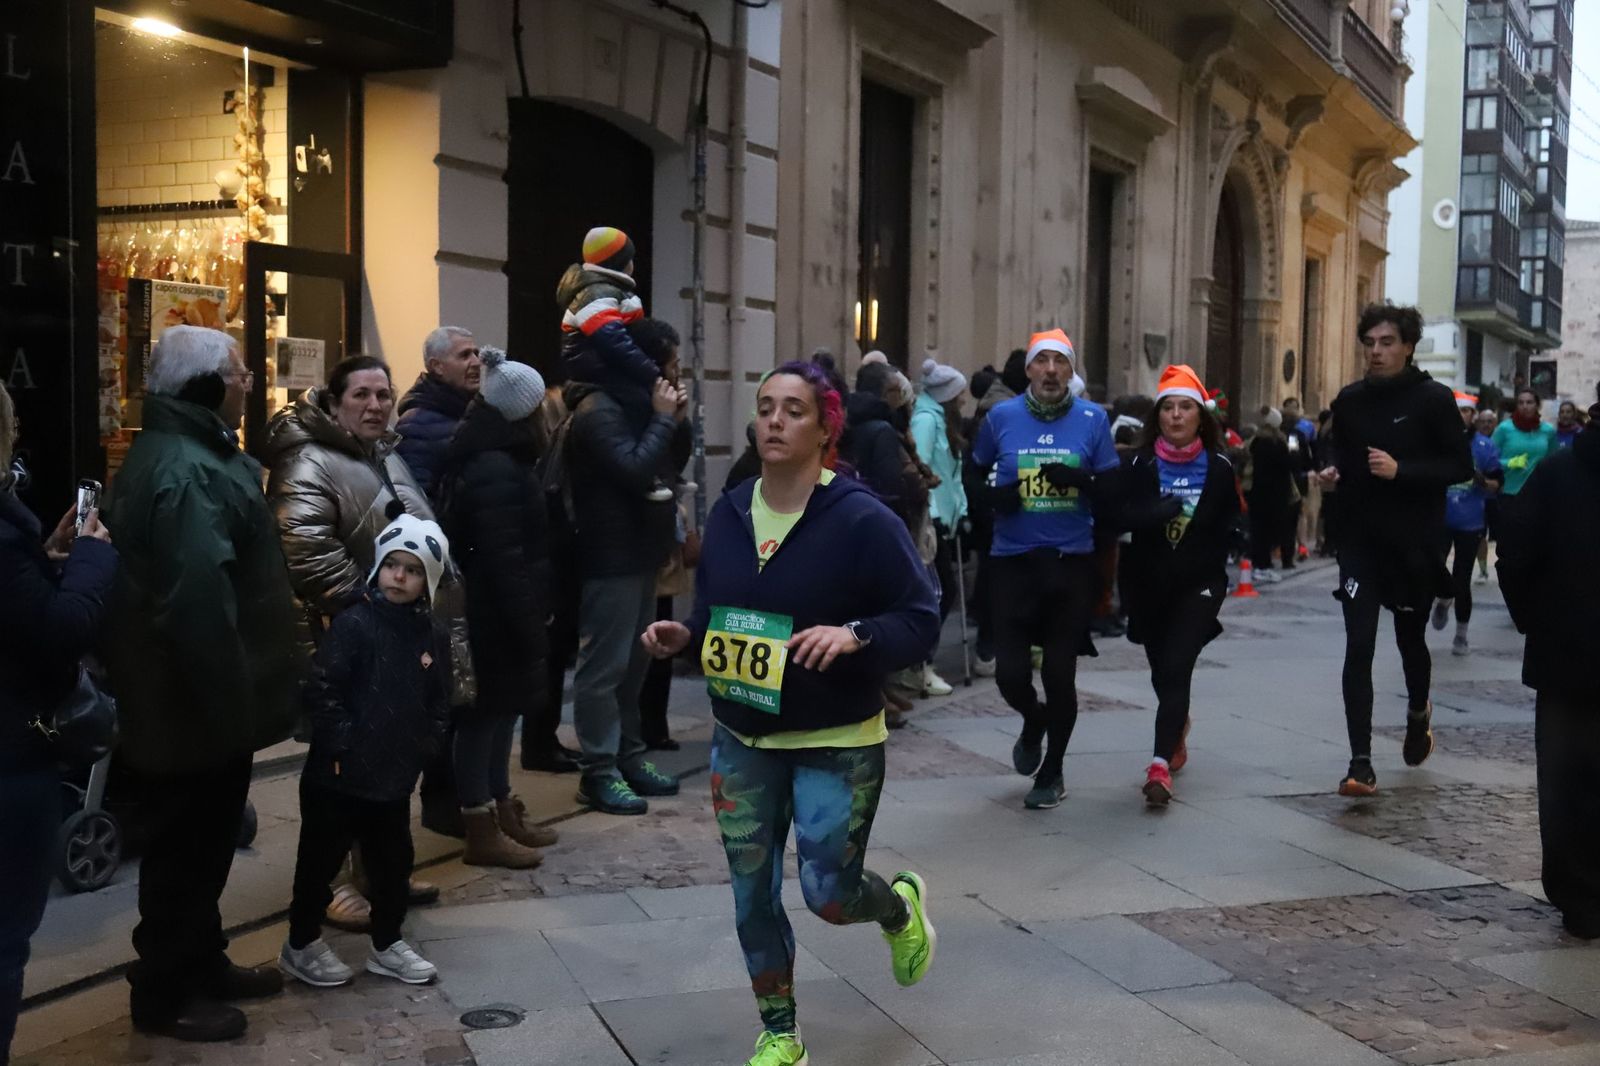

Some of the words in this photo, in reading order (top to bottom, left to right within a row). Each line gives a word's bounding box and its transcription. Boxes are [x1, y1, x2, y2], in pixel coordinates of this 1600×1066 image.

[1037, 434, 1053, 445] 46
[1173, 477, 1189, 487] 46
[740, 621, 765, 631] RURAL
[707, 635, 771, 681] 378
[748, 691, 775, 706] RURAL
